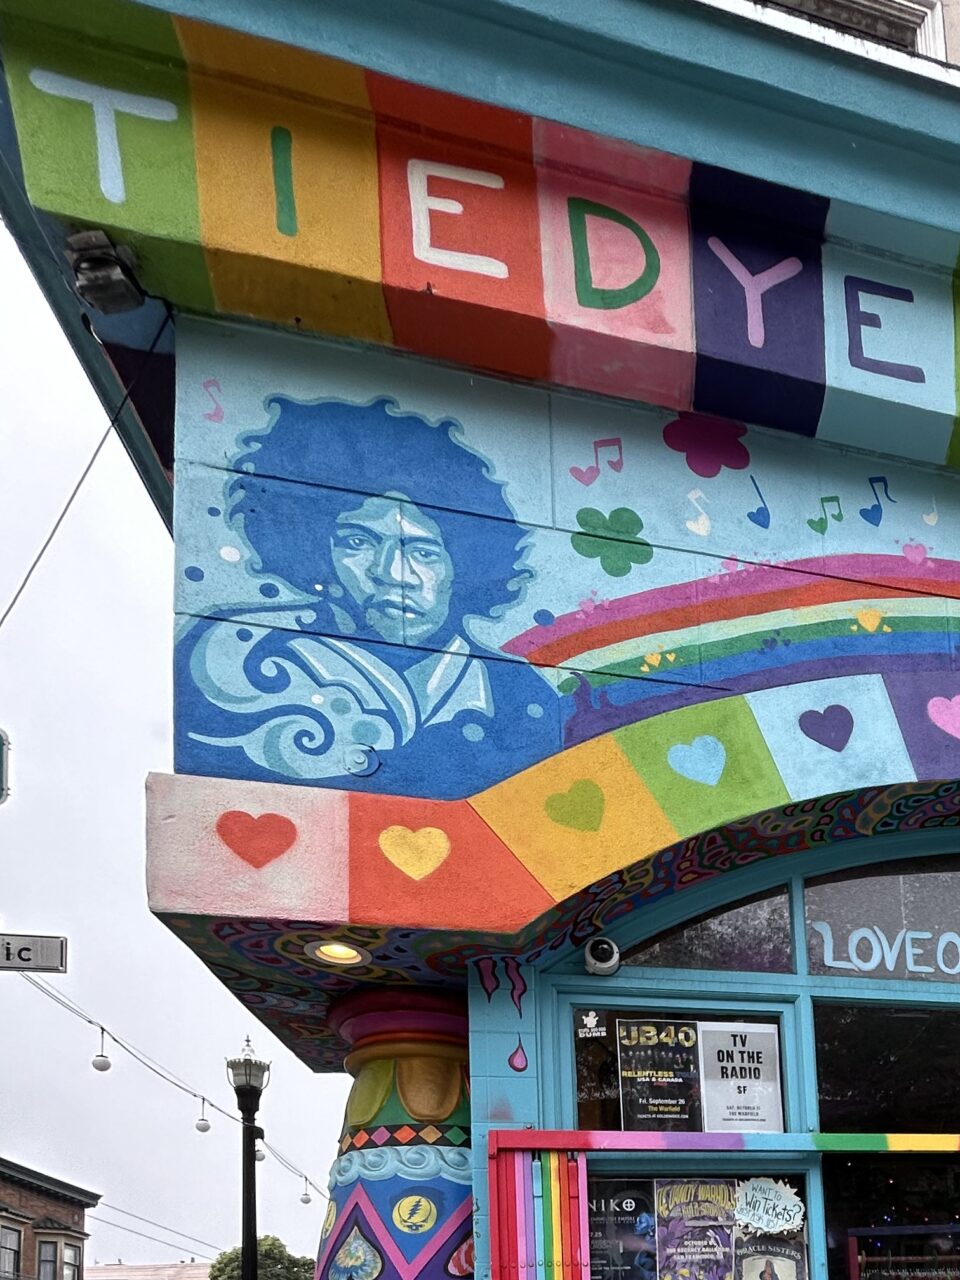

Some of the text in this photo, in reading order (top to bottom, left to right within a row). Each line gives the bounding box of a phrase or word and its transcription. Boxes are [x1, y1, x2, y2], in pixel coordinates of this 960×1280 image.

[619, 1025, 697, 1048] UB40
[730, 1034, 748, 1048] TV
[716, 1050, 763, 1065] ON THE
[621, 1070, 674, 1078] RELENTLESS
[720, 1066, 761, 1080] RADIO
[737, 1085, 748, 1095] SF
[751, 1183, 782, 1201] WANT TO
[745, 1192, 761, 1212] Win
[767, 1244, 802, 1260] SISTERS
